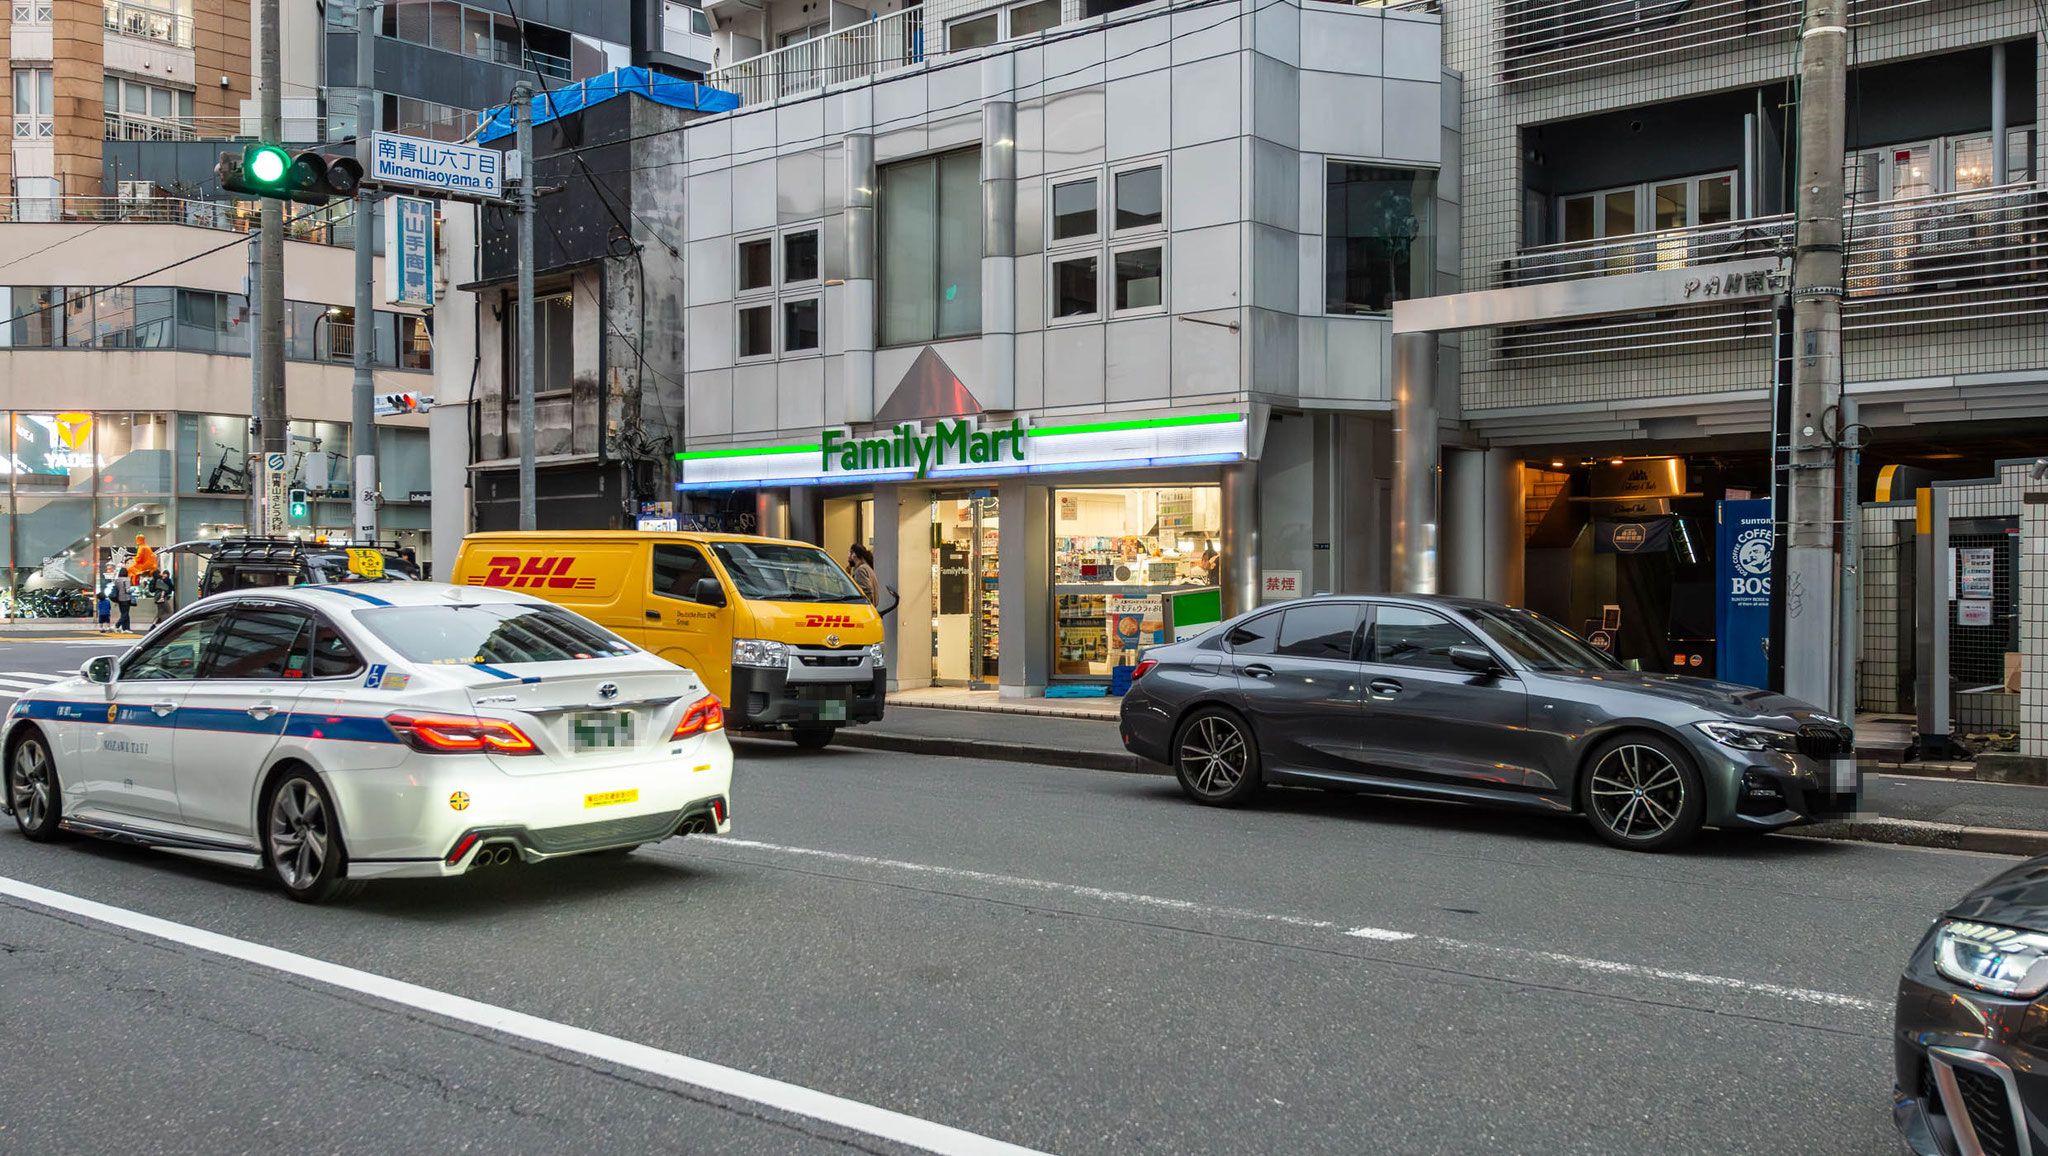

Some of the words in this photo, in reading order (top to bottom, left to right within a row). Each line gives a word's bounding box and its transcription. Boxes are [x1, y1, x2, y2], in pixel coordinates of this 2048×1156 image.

[378, 139, 495, 174] 南青山六丁目
[380, 160, 480, 187] Minamiaoyama
[485, 176, 494, 189] 6
[822, 418, 1025, 479] FamilyMart
[43, 453, 106, 470] YADEA
[271, 472, 283, 532] 南青山さとう内科
[1738, 528, 1772, 543] COFFE
[484, 557, 578, 589] DHL
[1266, 577, 1296, 591] 禁煙
[1731, 578, 1771, 594] BOS
[805, 615, 855, 627] DHL
